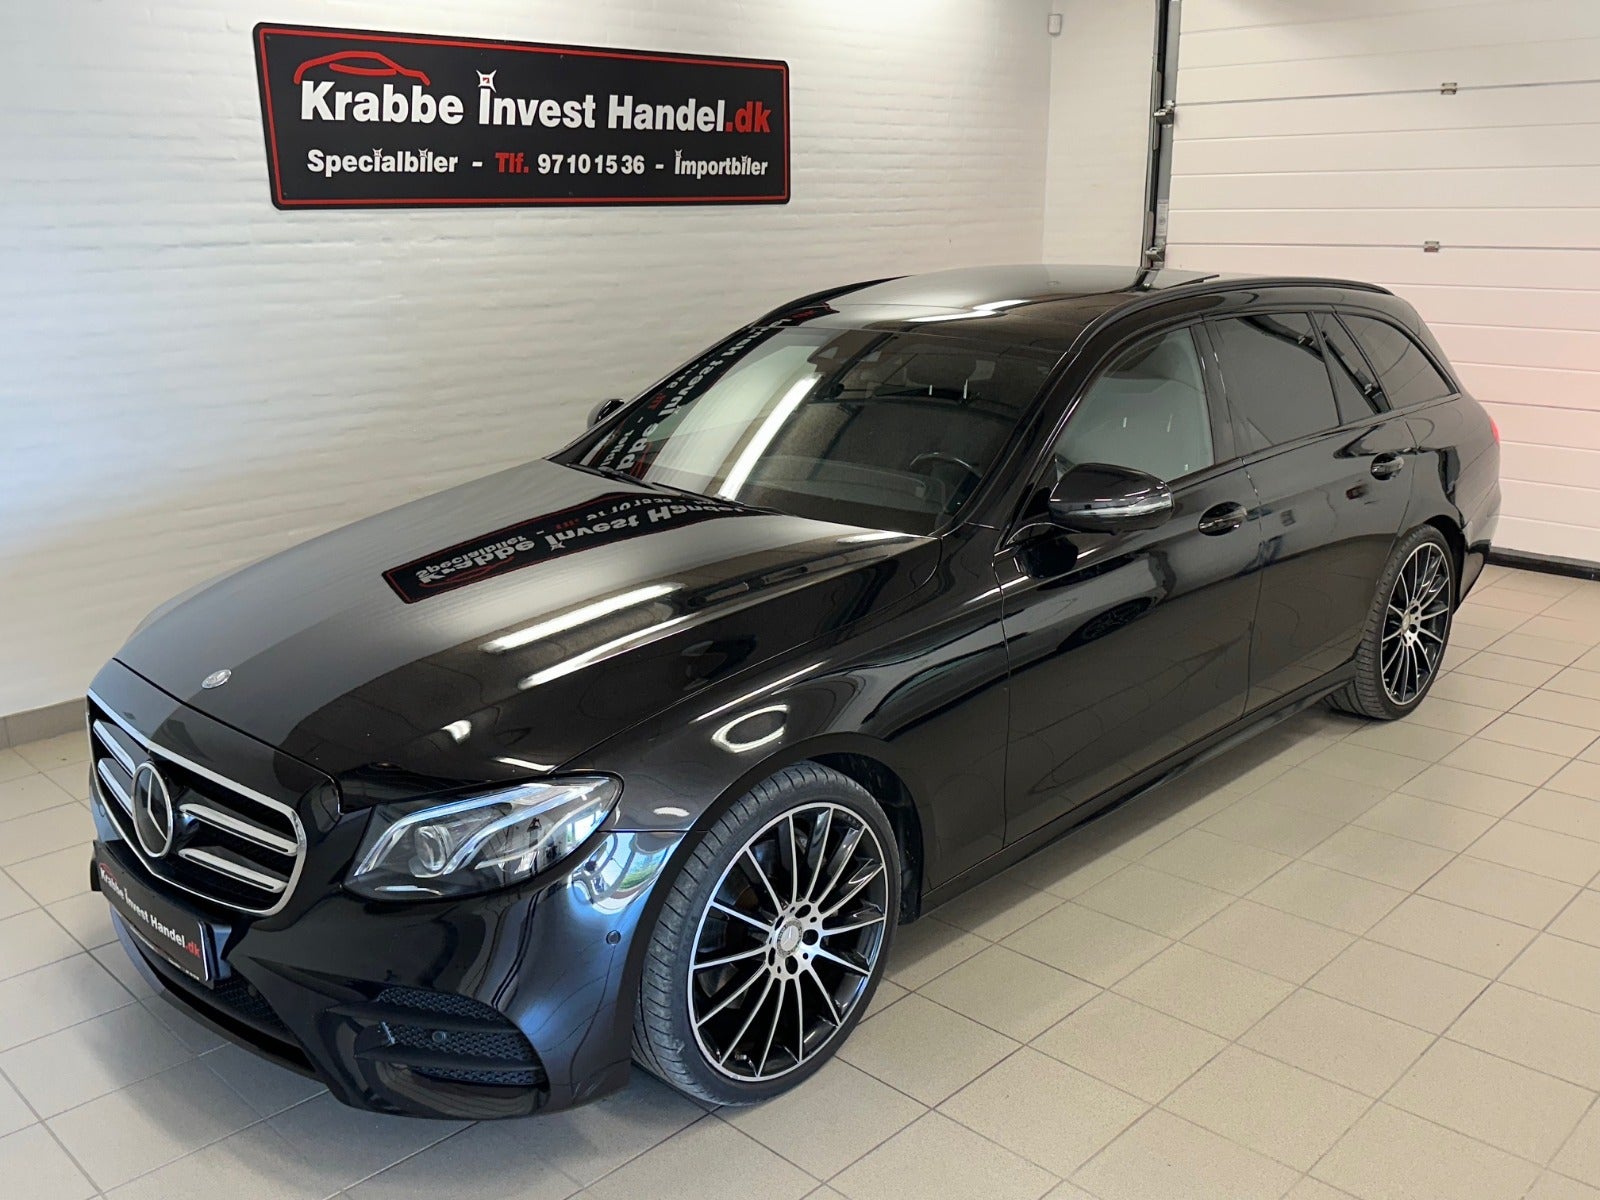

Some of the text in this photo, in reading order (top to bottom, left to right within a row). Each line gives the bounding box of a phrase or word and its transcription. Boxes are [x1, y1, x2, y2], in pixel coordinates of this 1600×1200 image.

[301, 70, 771, 133] Krabbe Invest Handel.dk
[307, 148, 458, 177] Specialbiler
[495, 152, 529, 173] Tlf.
[674, 149, 768, 179] Importbiler
[150, 914, 201, 959] Handel.dk
